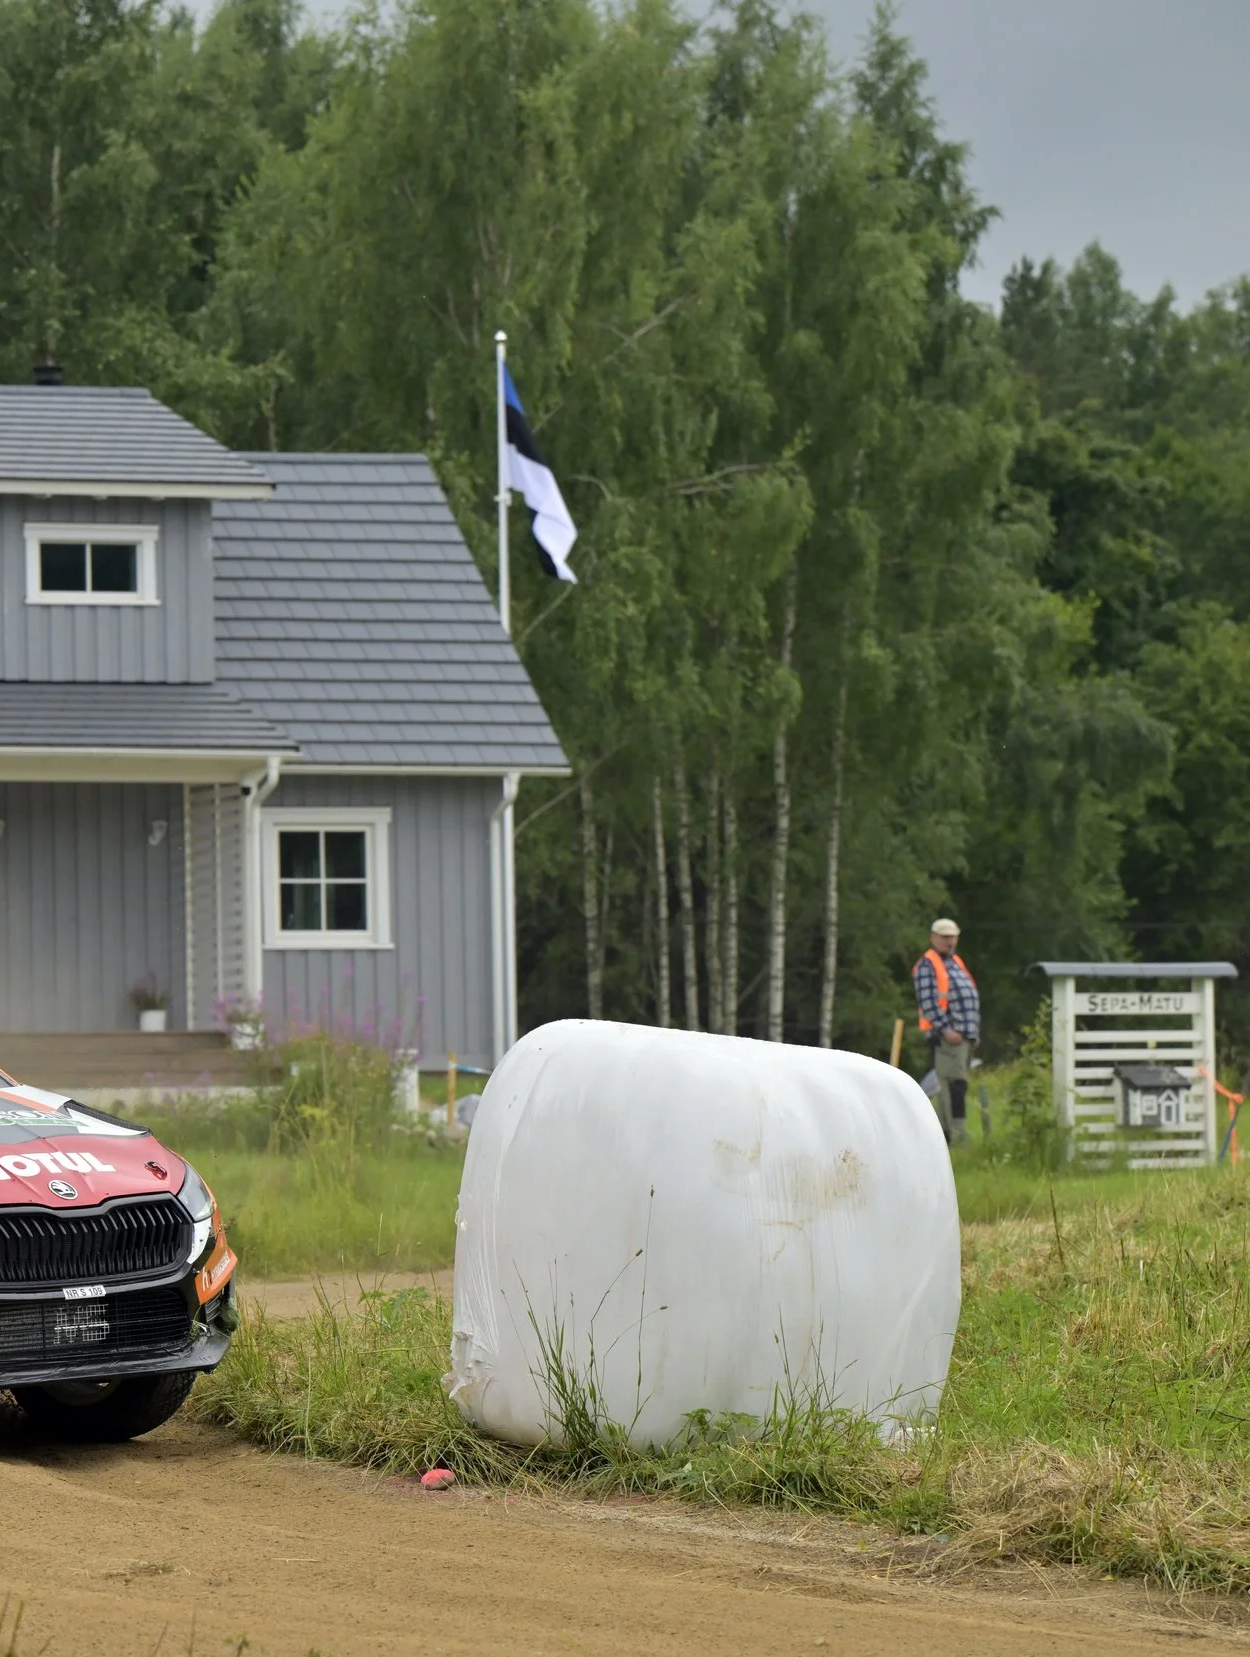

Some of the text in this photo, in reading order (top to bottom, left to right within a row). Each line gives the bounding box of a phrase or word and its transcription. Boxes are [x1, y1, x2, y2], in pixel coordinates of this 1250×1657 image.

[66, 1287, 103, 1299] NR S 109
